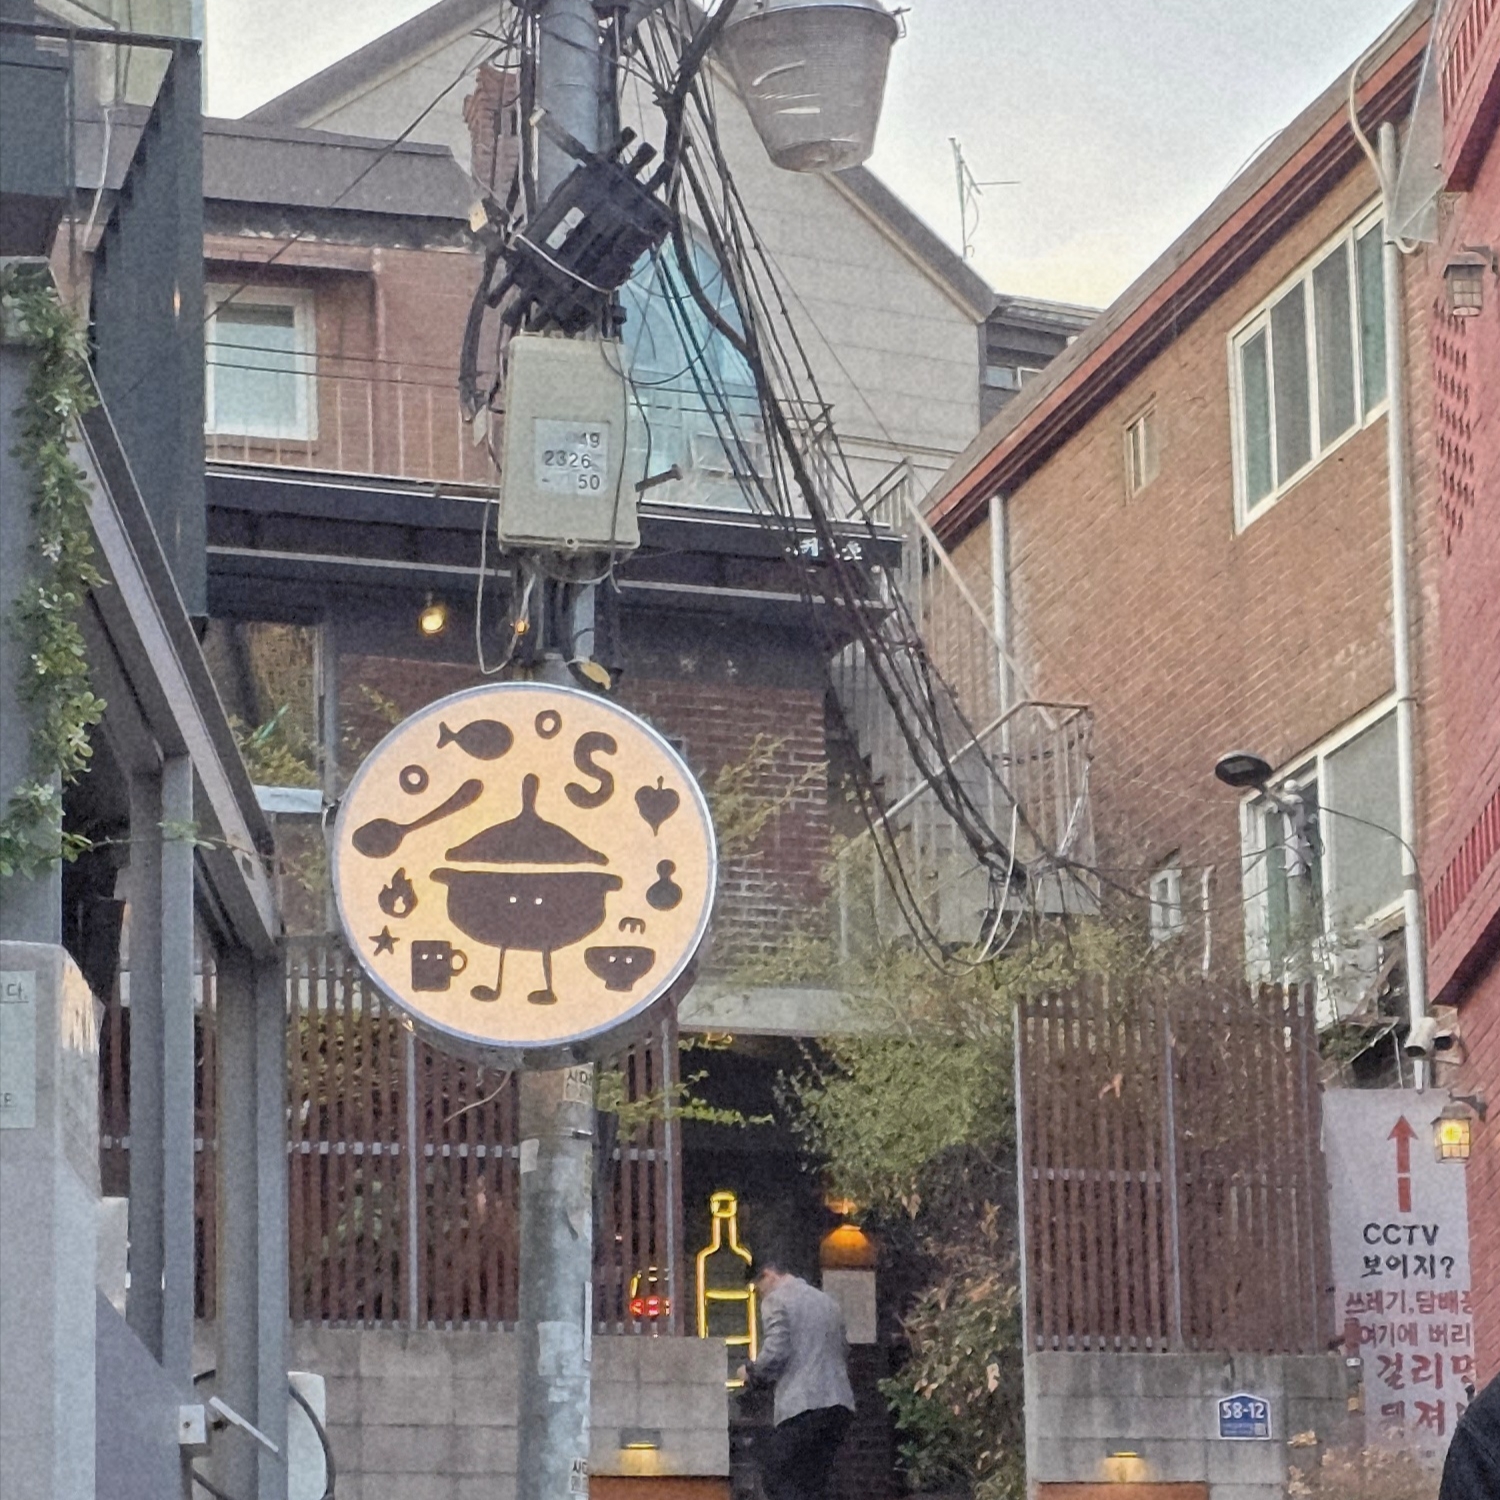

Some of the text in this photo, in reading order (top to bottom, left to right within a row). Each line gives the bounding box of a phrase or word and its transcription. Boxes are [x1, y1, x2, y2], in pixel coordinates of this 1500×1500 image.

[543, 449, 592, 469] 2326
[1363, 1222, 1439, 1246] CCTV
[1360, 1253, 1455, 1280] 보이지?
[1360, 1322, 1418, 1348] 여기에
[1222, 1402, 1265, 1419] 58-12
